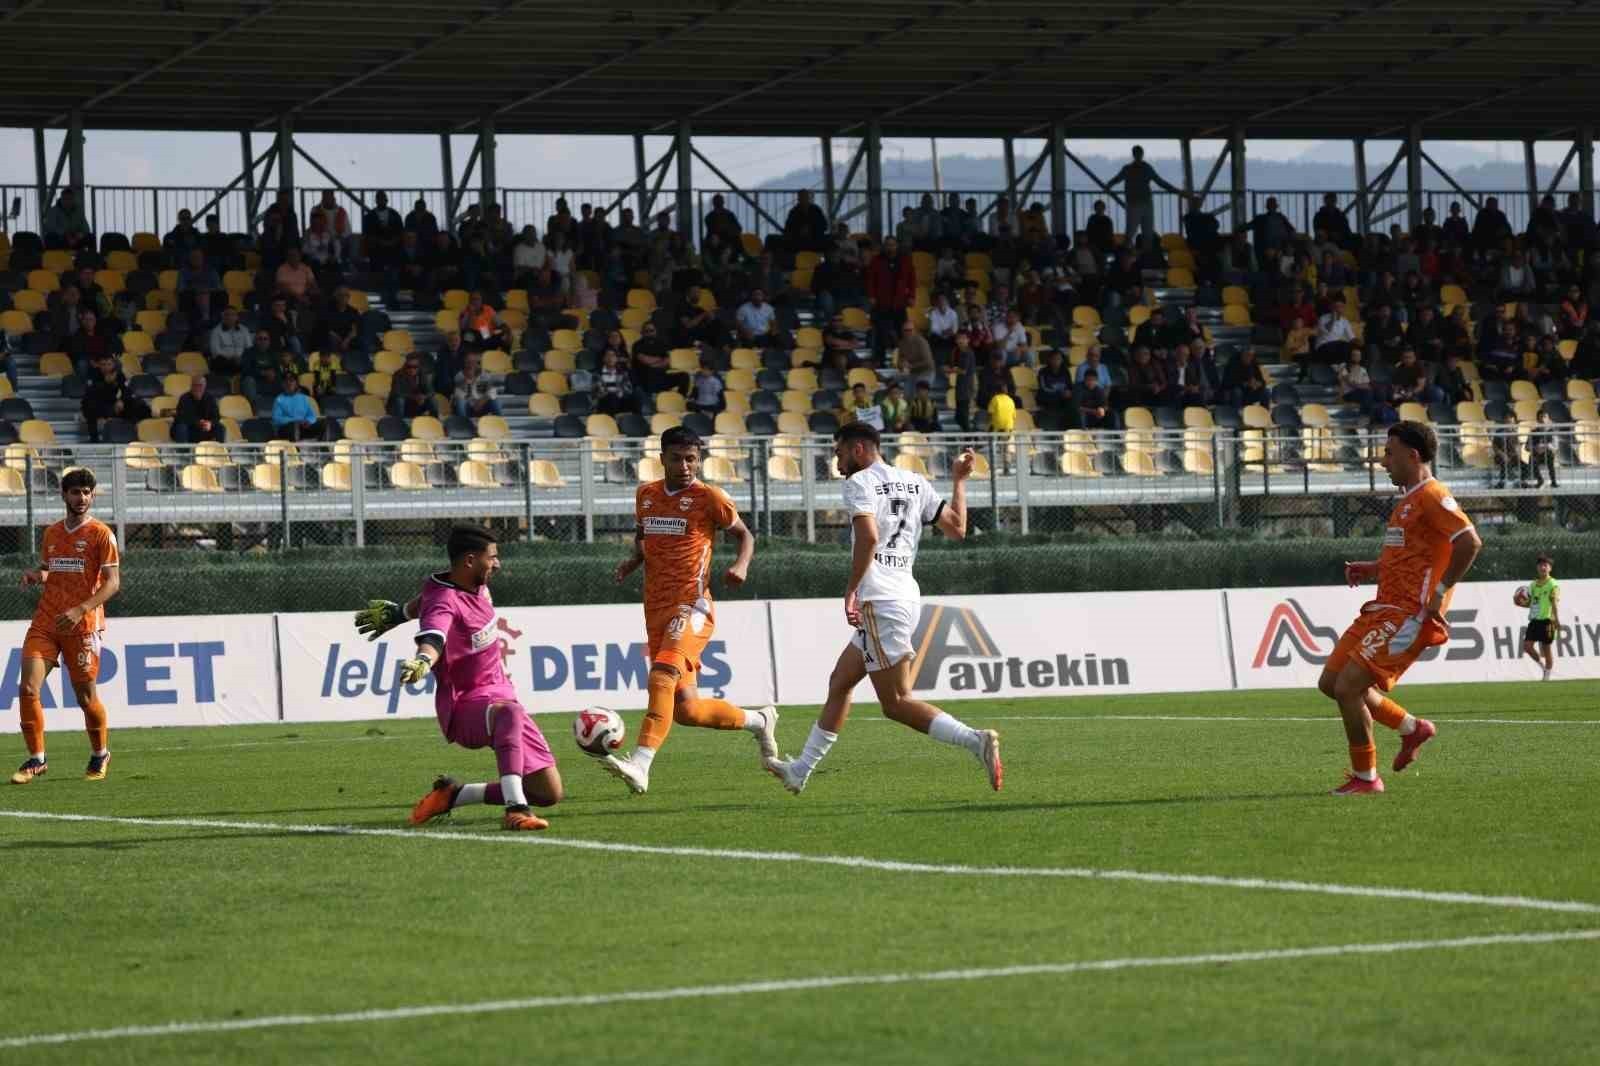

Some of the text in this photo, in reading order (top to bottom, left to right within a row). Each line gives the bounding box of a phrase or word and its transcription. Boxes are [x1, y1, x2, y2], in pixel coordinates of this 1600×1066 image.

[887, 497, 910, 549] 7
[1493, 616, 1600, 660] HRİY
[530, 641, 732, 699] DEMŞ
[949, 653, 1129, 693] aytekin
